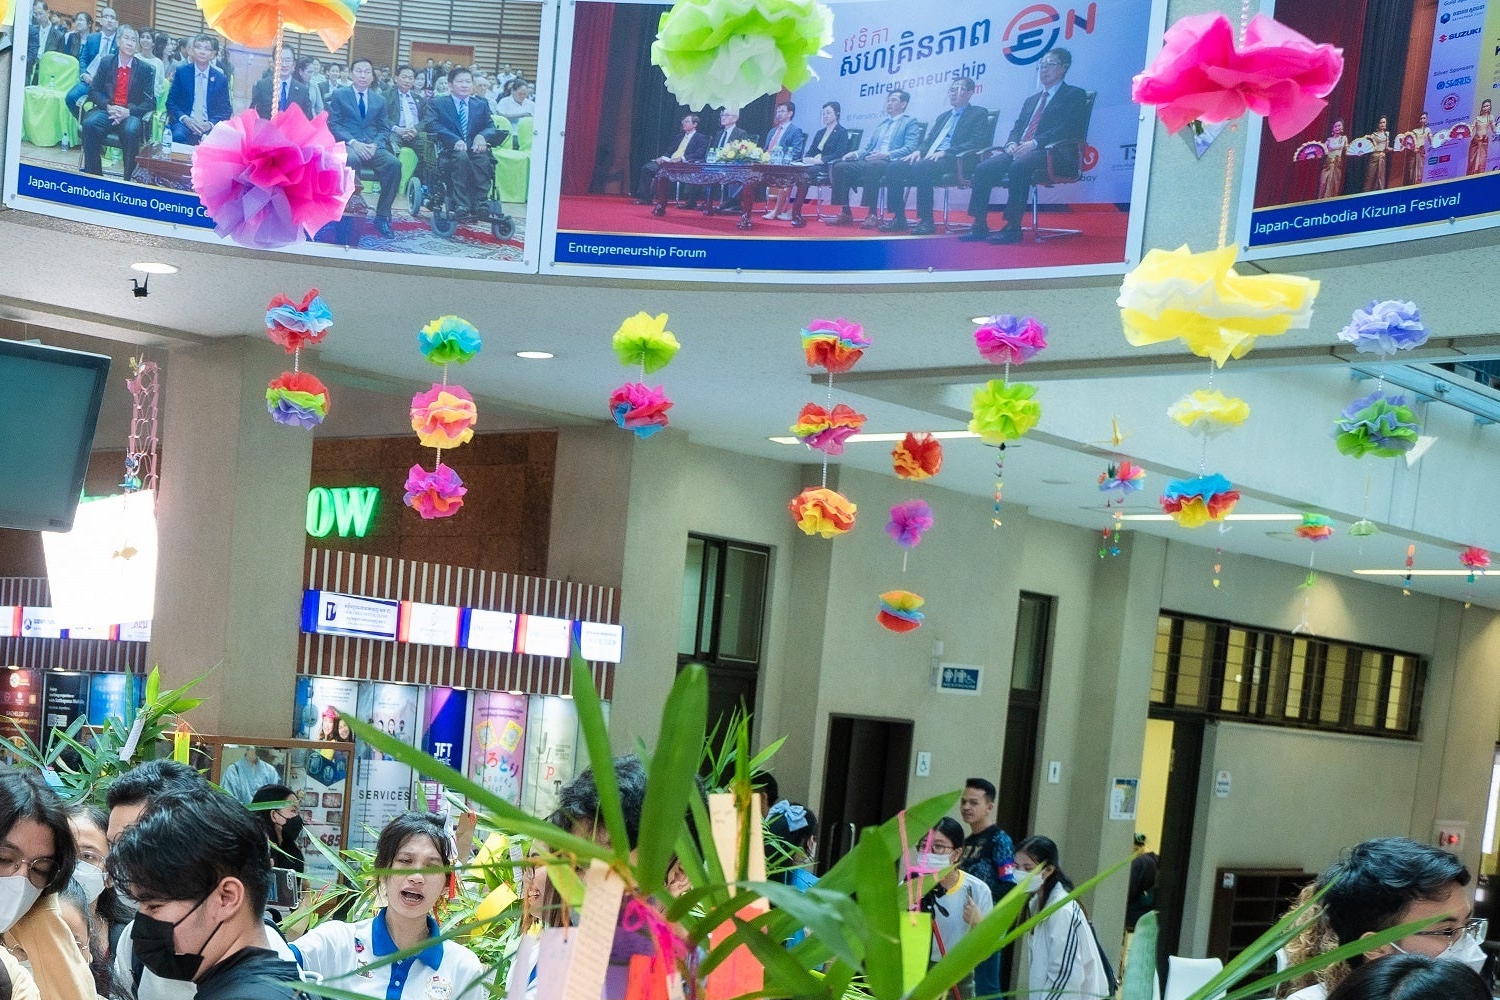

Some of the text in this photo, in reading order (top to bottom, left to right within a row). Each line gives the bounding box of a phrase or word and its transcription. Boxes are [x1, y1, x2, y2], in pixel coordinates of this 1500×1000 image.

[1449, 27, 1482, 40] SUZUKI
[859, 61, 987, 98] Entrepreneurship
[28, 175, 111, 201] Japan-Cambodia
[112, 191, 148, 208] Kizuna
[150, 198, 193, 218] Opening
[1254, 192, 1461, 235] Japan-Cambodia Kizuna Festival
[568, 242, 707, 259] Entrepreneurship Forum
[305, 486, 381, 538] OW
[433, 742, 453, 757] JFT
[358, 789, 411, 801] SERVICES
